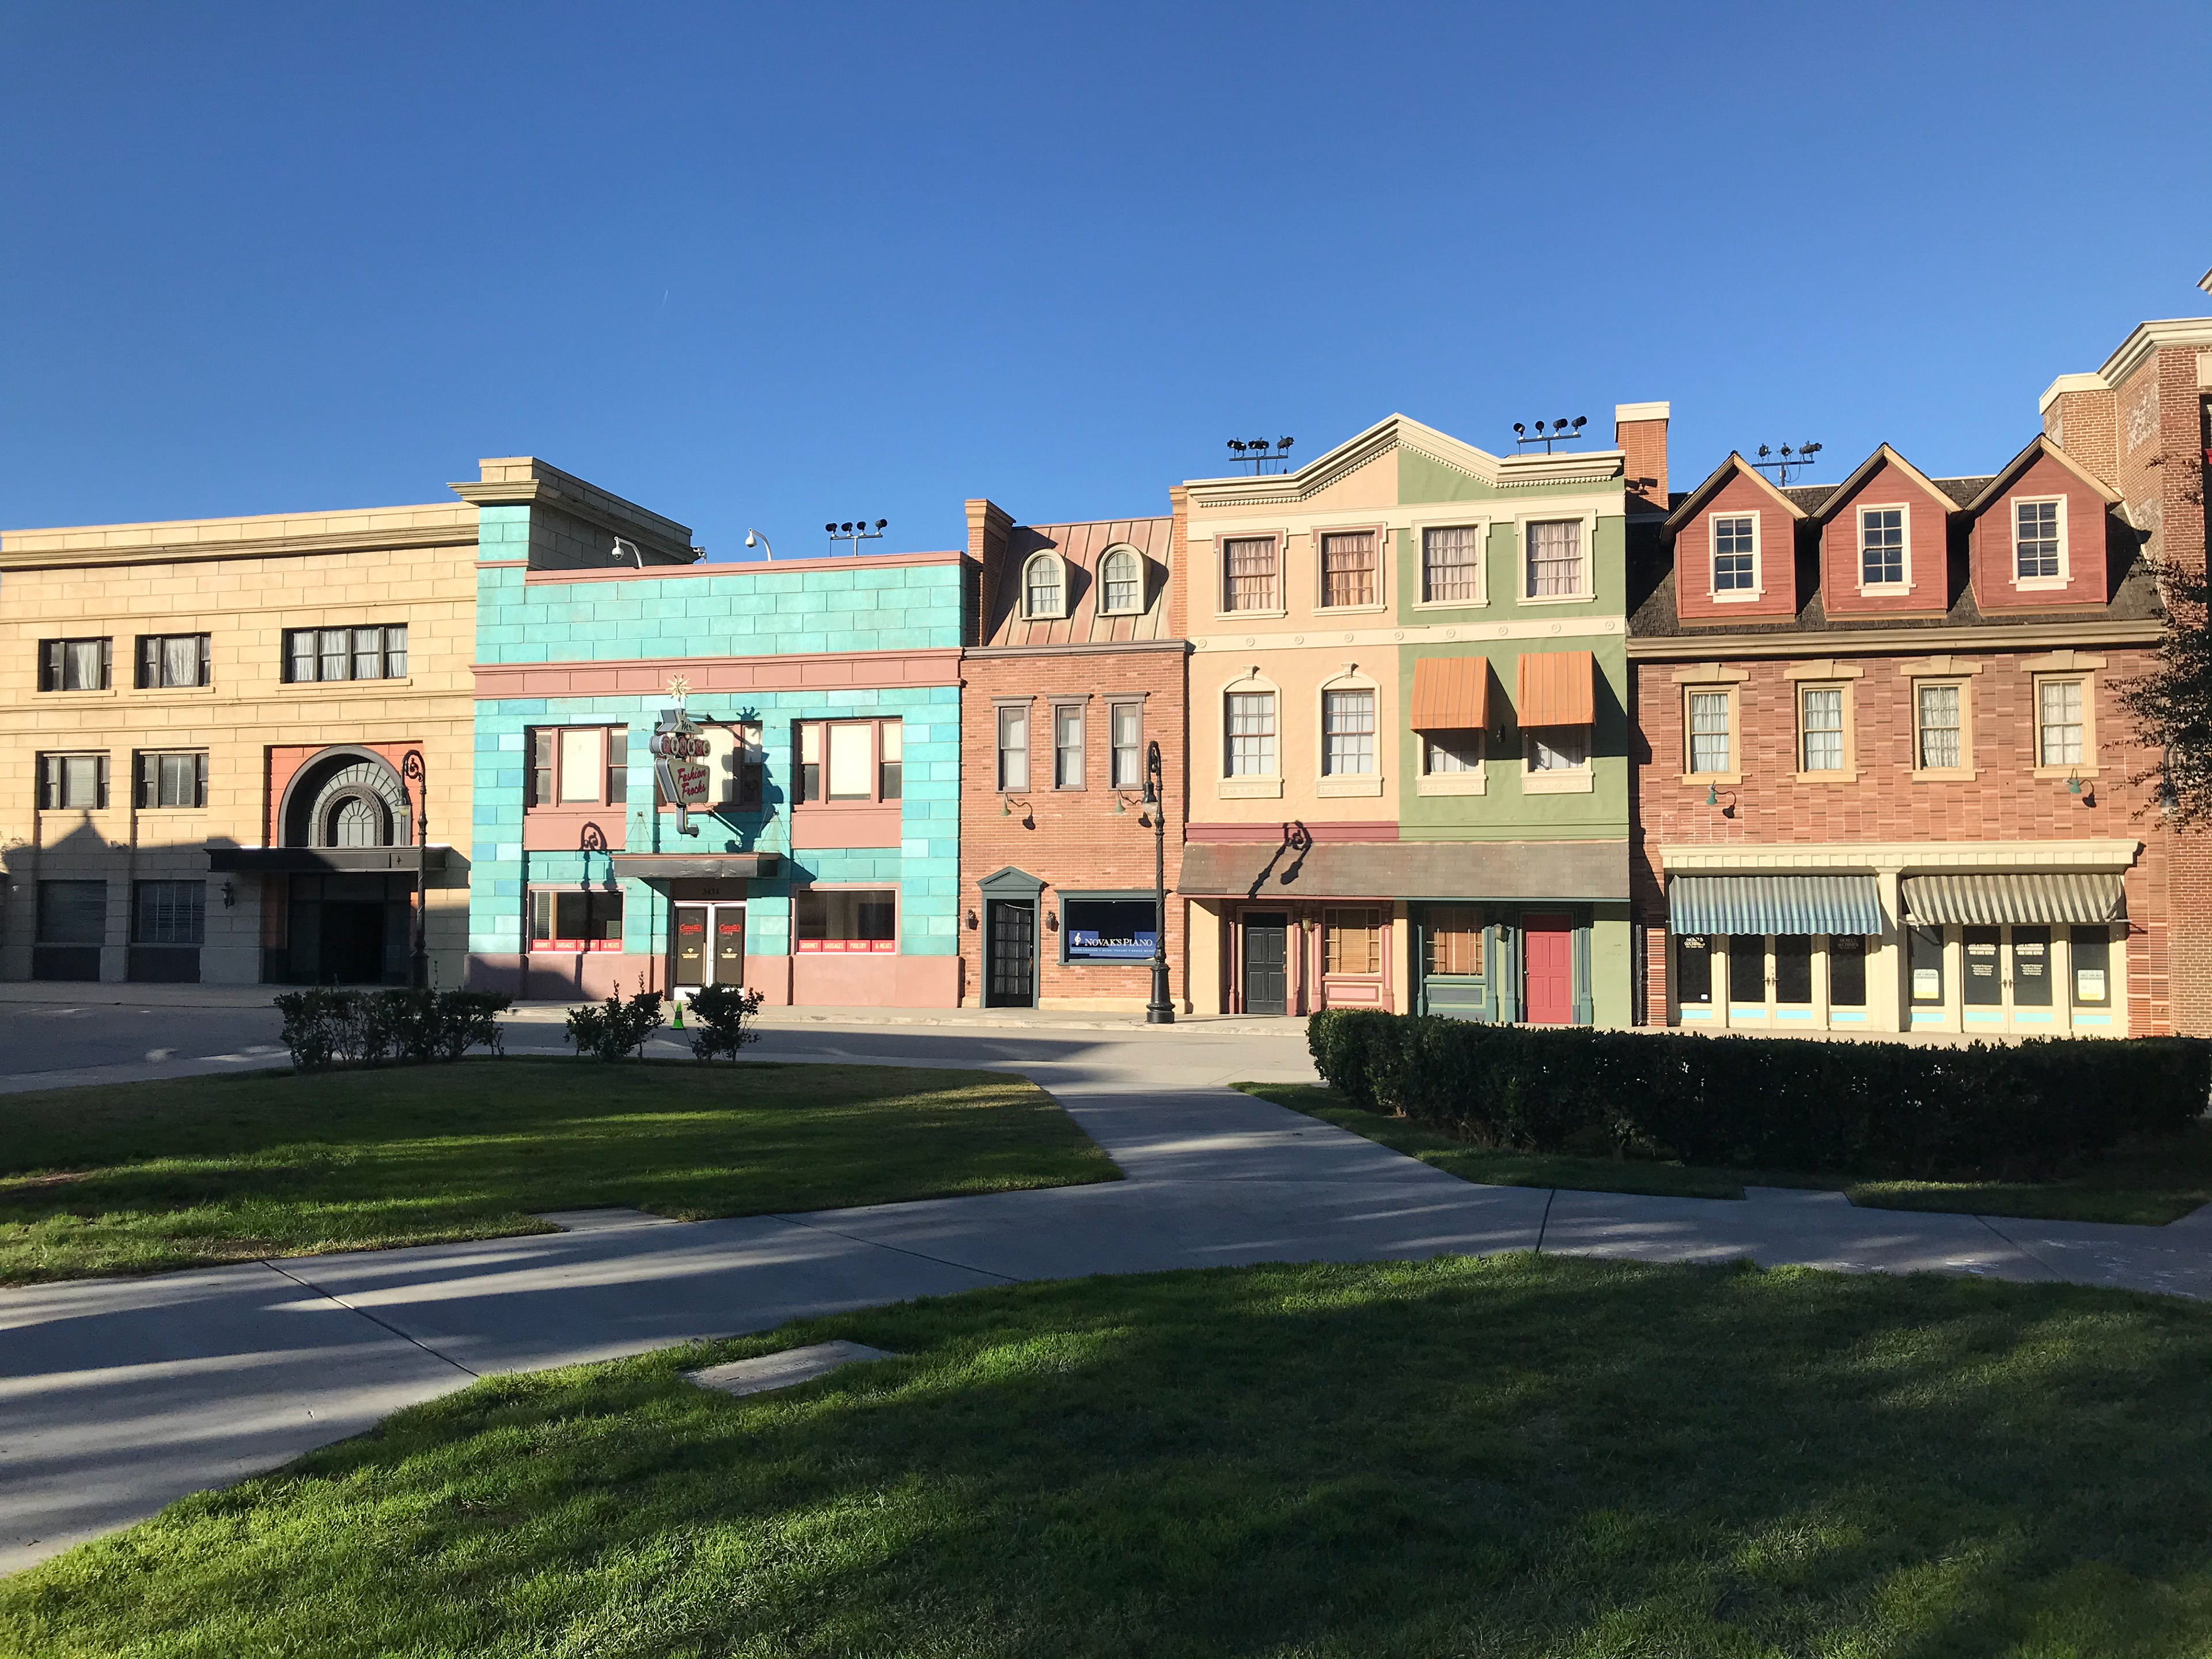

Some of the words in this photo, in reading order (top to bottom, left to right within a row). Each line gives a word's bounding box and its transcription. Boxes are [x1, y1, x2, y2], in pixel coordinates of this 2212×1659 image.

[680, 719, 695, 732] Mr.
[662, 738, 710, 754] PINKYS
[677, 767, 707, 783] Fashion
[681, 779, 707, 799] Frocks
[1084, 938, 1122, 946] NOVAK'S
[1123, 938, 1153, 946] PIANO
